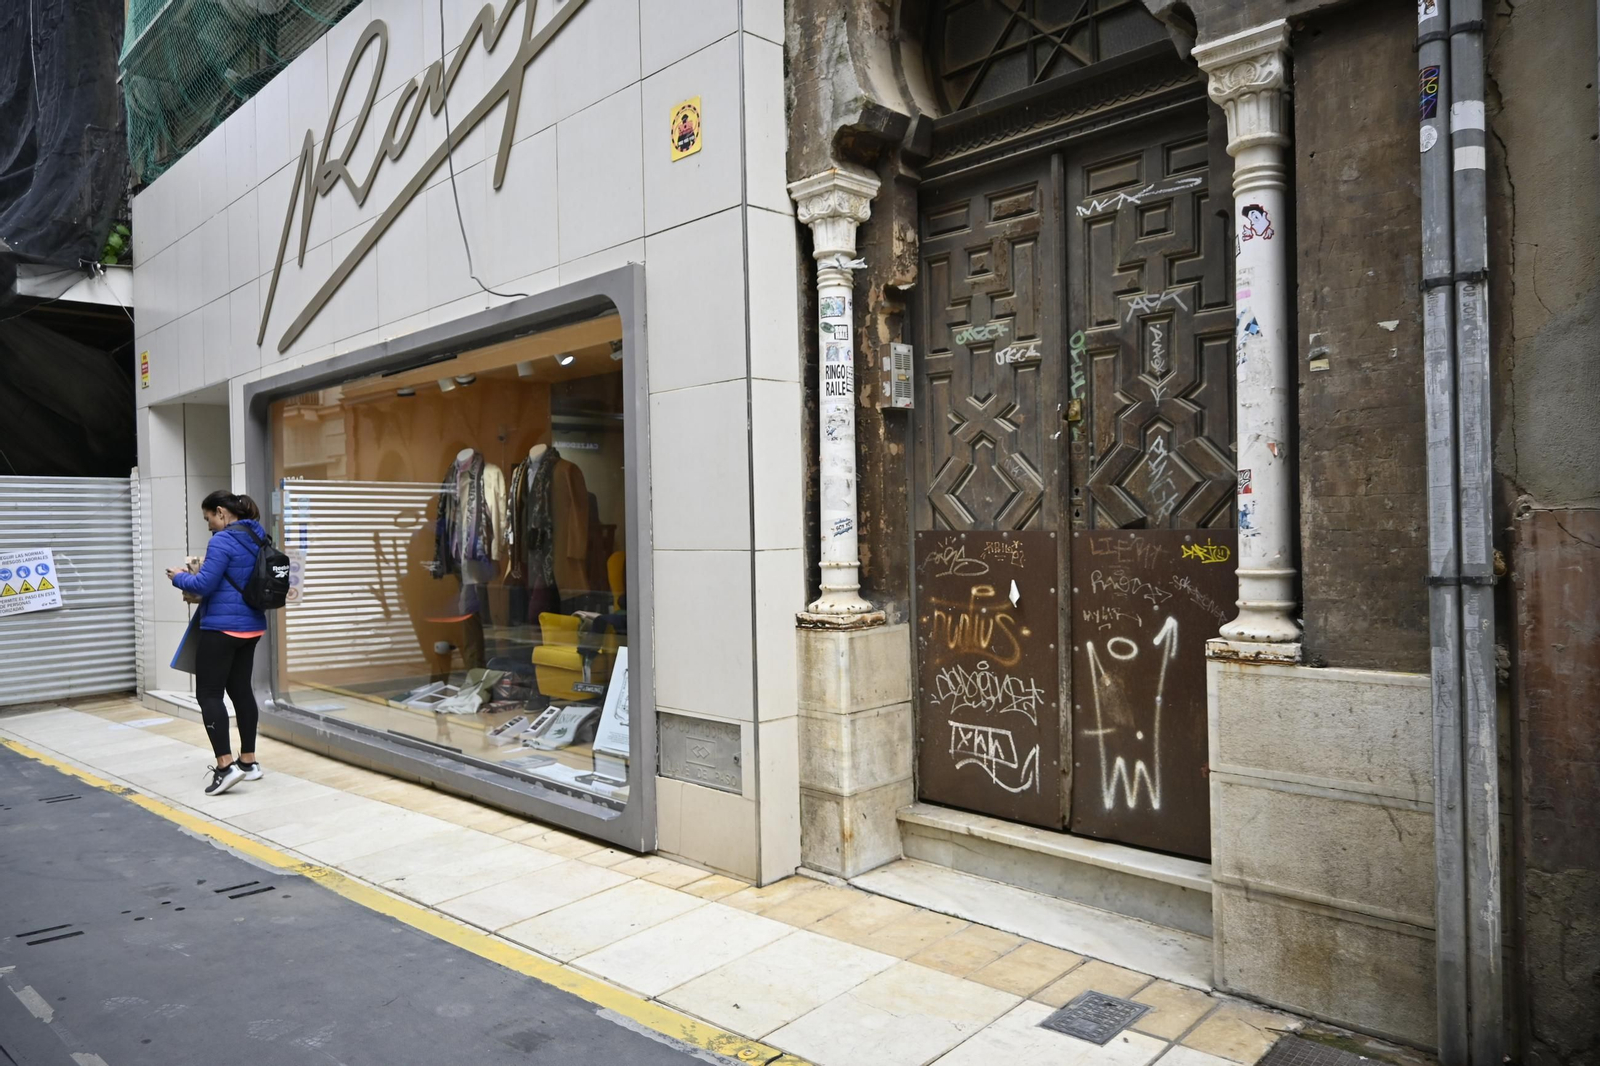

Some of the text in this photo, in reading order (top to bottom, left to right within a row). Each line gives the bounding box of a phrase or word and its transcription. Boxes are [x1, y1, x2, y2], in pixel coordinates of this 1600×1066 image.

[825, 364, 846, 380] RINGO
[825, 381, 847, 397] RAILE
[22, 555, 49, 563] LABORALES
[7, 600, 31, 608] PERSONAS
[715, 771, 737, 786] PASO
